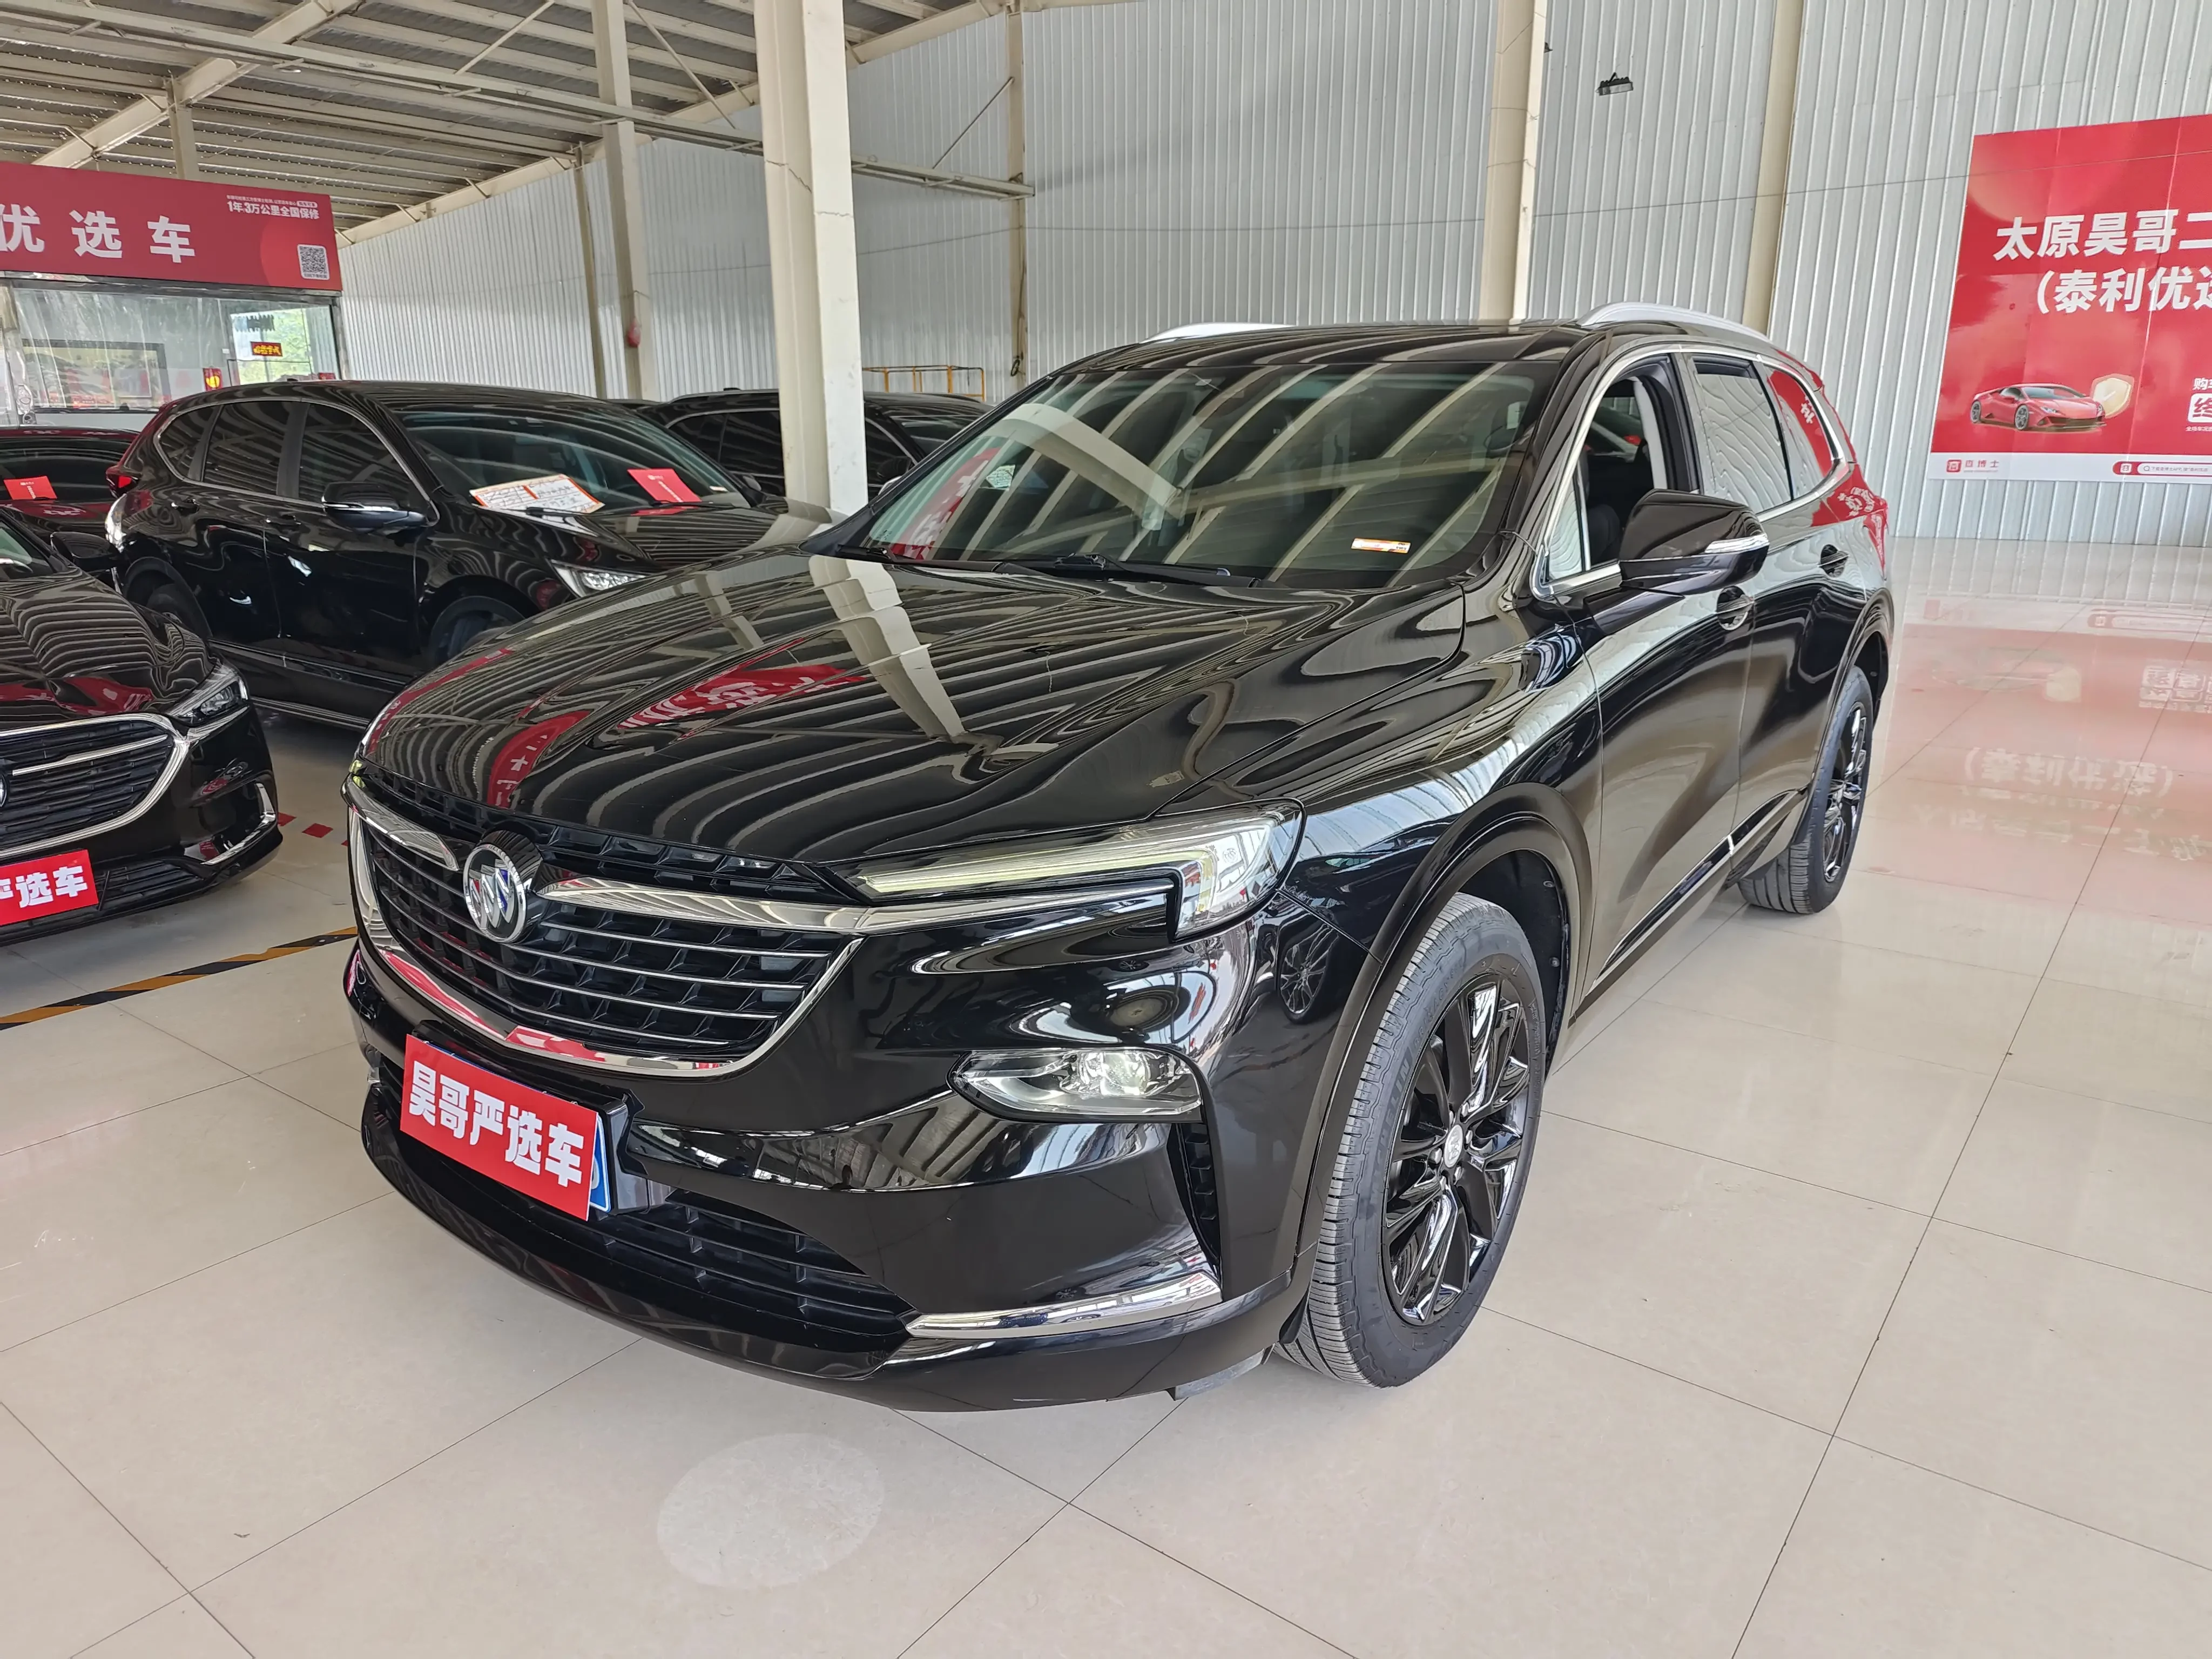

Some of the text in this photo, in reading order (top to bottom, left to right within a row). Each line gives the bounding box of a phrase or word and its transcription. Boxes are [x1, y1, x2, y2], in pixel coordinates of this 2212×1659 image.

[1993, 208, 2212, 261] 太原昊哥二
[409, 1060, 584, 1188] 昊哥严选车
